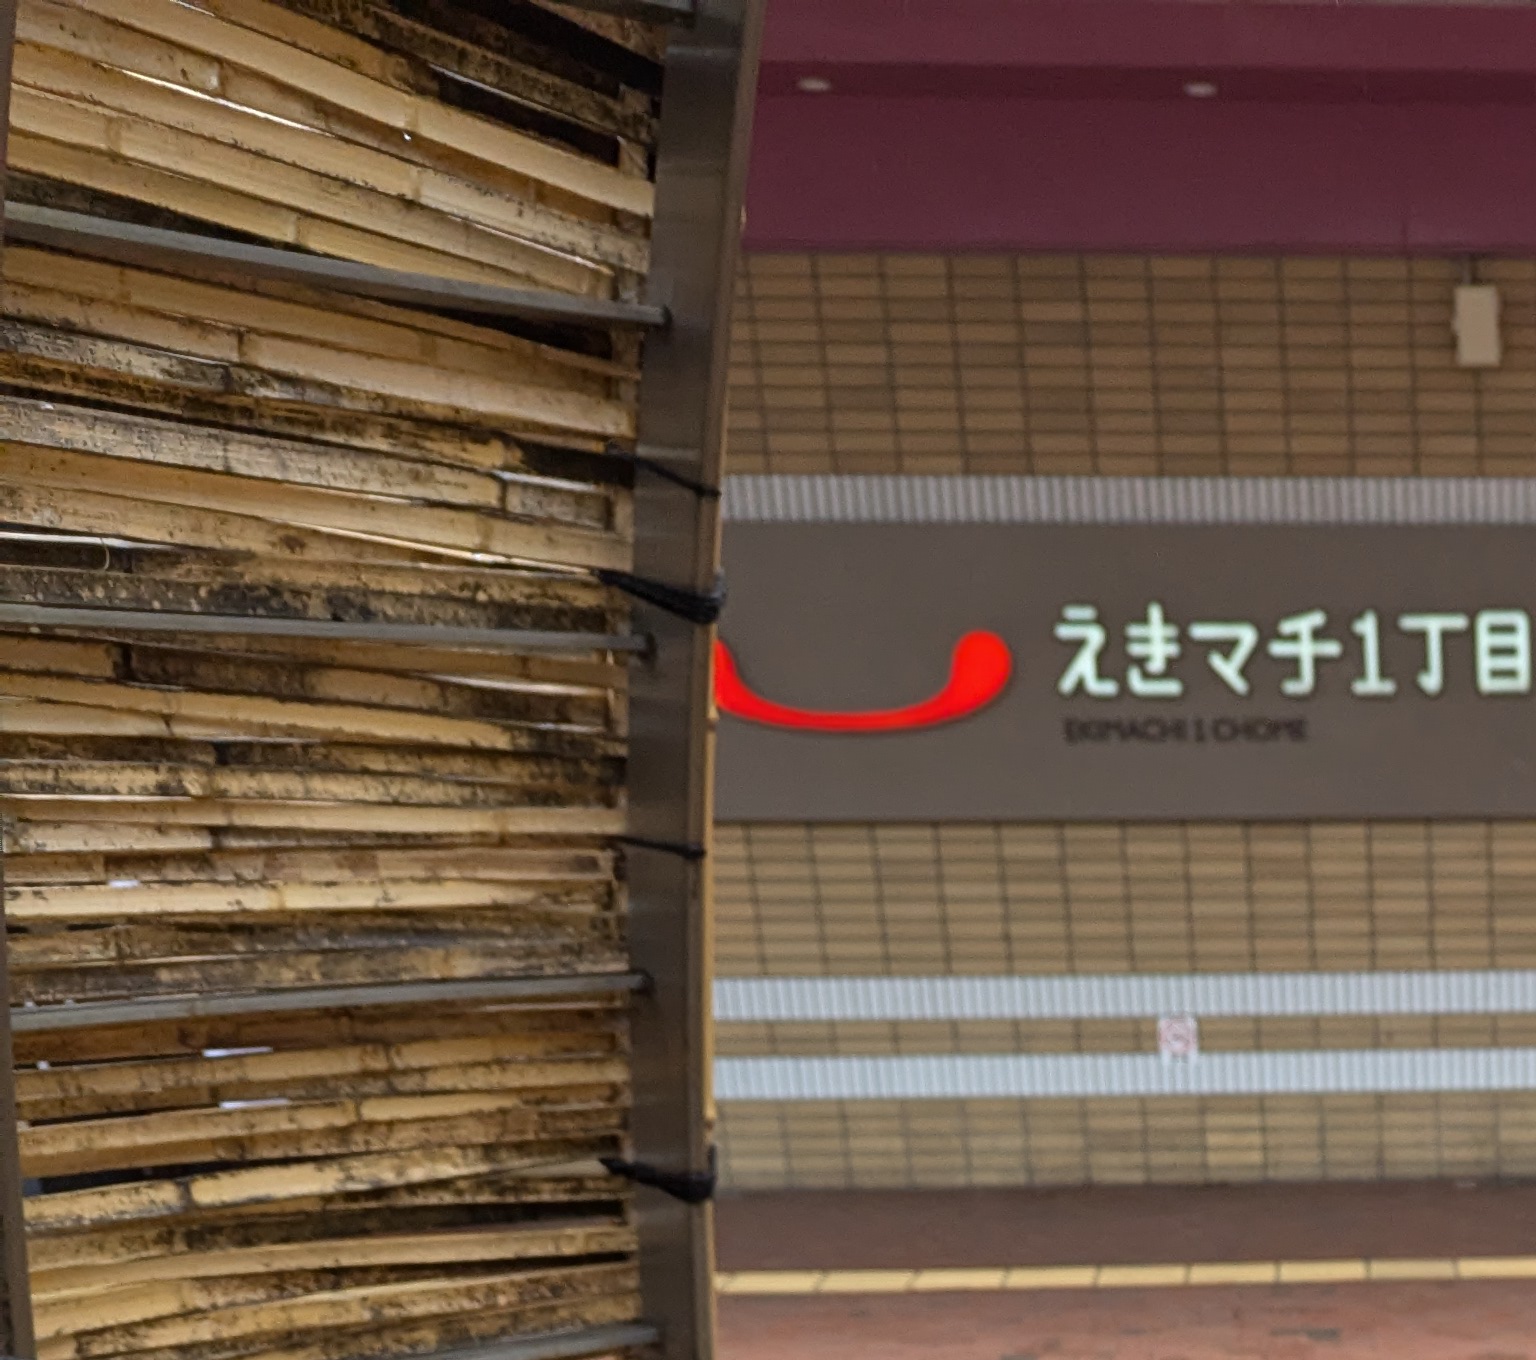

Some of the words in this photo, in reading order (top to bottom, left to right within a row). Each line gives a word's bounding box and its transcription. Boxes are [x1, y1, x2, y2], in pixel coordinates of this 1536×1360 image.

[1055, 602, 1531, 695] えきマチ1丁目
